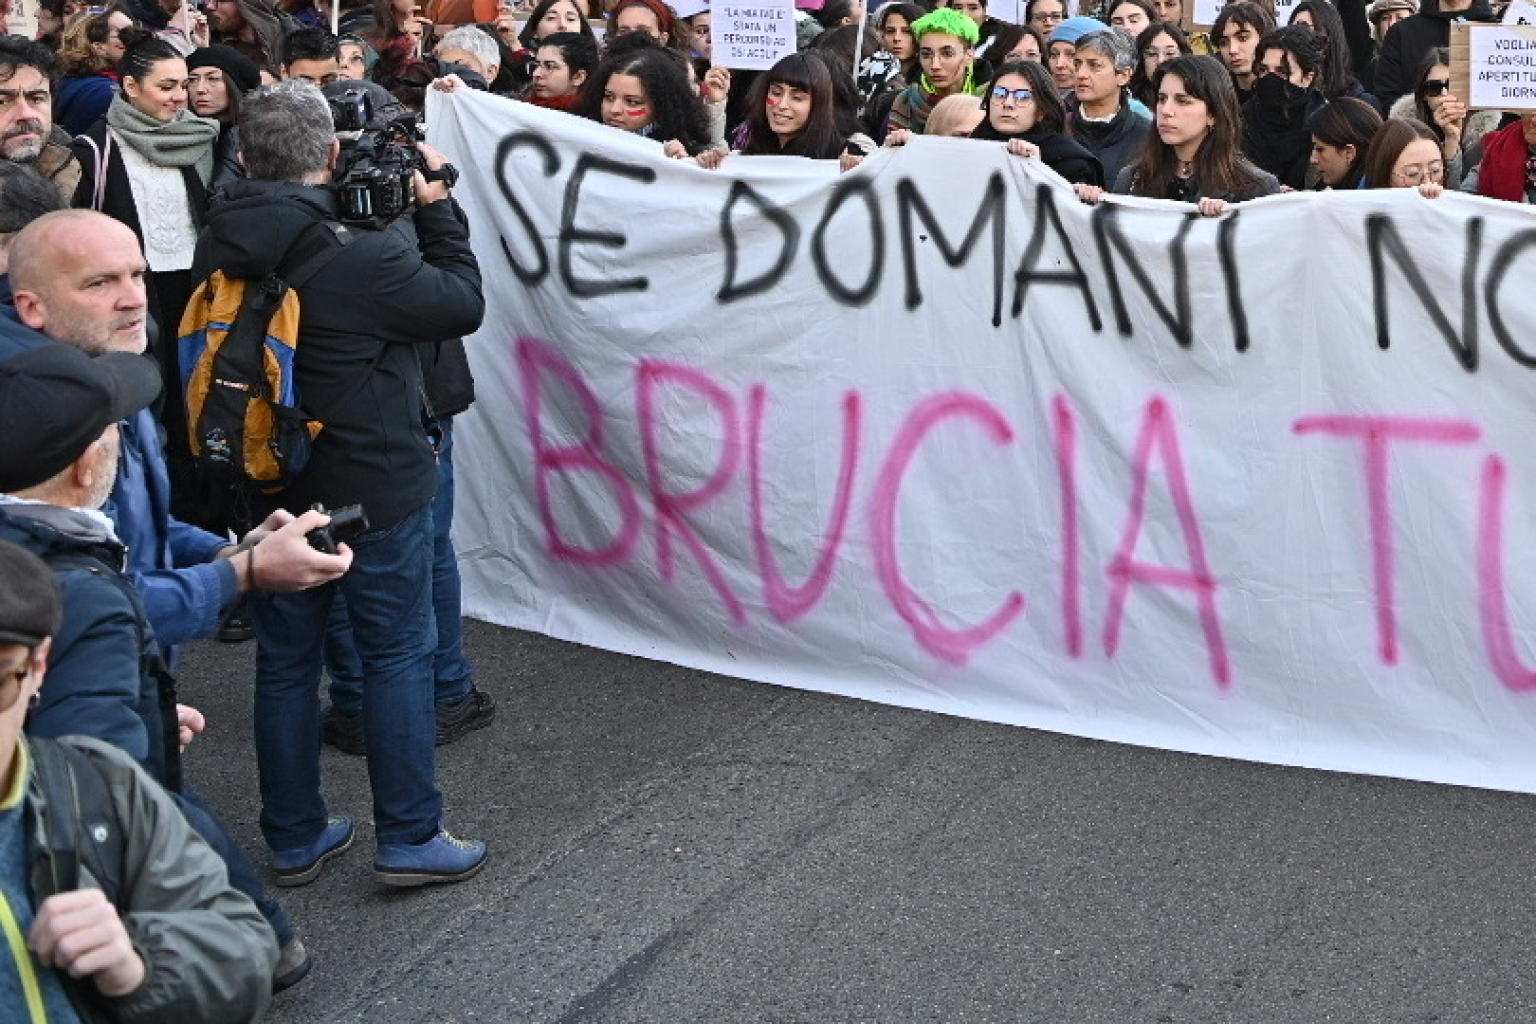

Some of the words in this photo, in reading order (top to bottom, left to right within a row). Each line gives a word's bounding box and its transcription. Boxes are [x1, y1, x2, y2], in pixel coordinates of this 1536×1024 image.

[1478, 71, 1520, 82] APERTI
[491, 128, 656, 300] SE
[715, 167, 1253, 353] DOMANI
[514, 334, 1235, 692] BRUCIA
